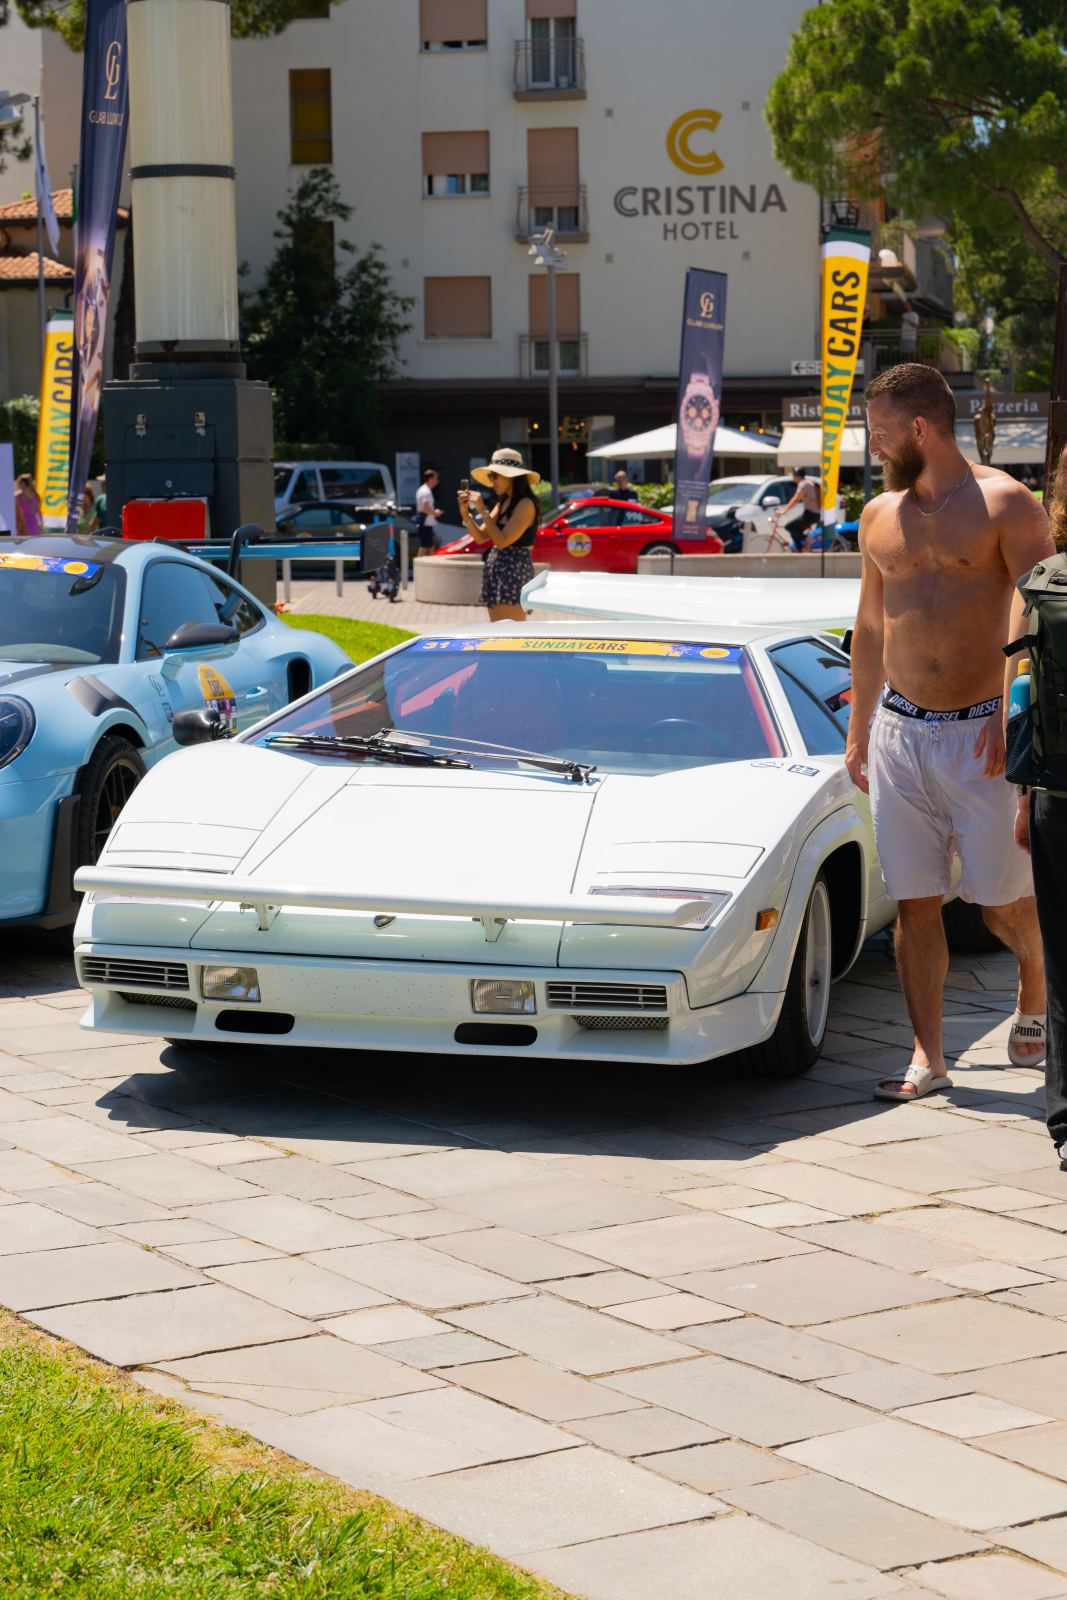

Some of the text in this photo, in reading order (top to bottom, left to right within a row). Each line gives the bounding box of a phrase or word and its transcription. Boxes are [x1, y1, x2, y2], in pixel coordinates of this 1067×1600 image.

[613, 184, 787, 217] CRISTINA
[663, 221, 739, 241] HOTEL
[970, 398, 1039, 413] Pizeria
[422, 641, 628, 651] 31 SUNDAYCARS
[889, 694, 918, 715] DIESEL
[924, 711, 960, 721] DIESEL
[1014, 1026, 1041, 1037] PUMA
